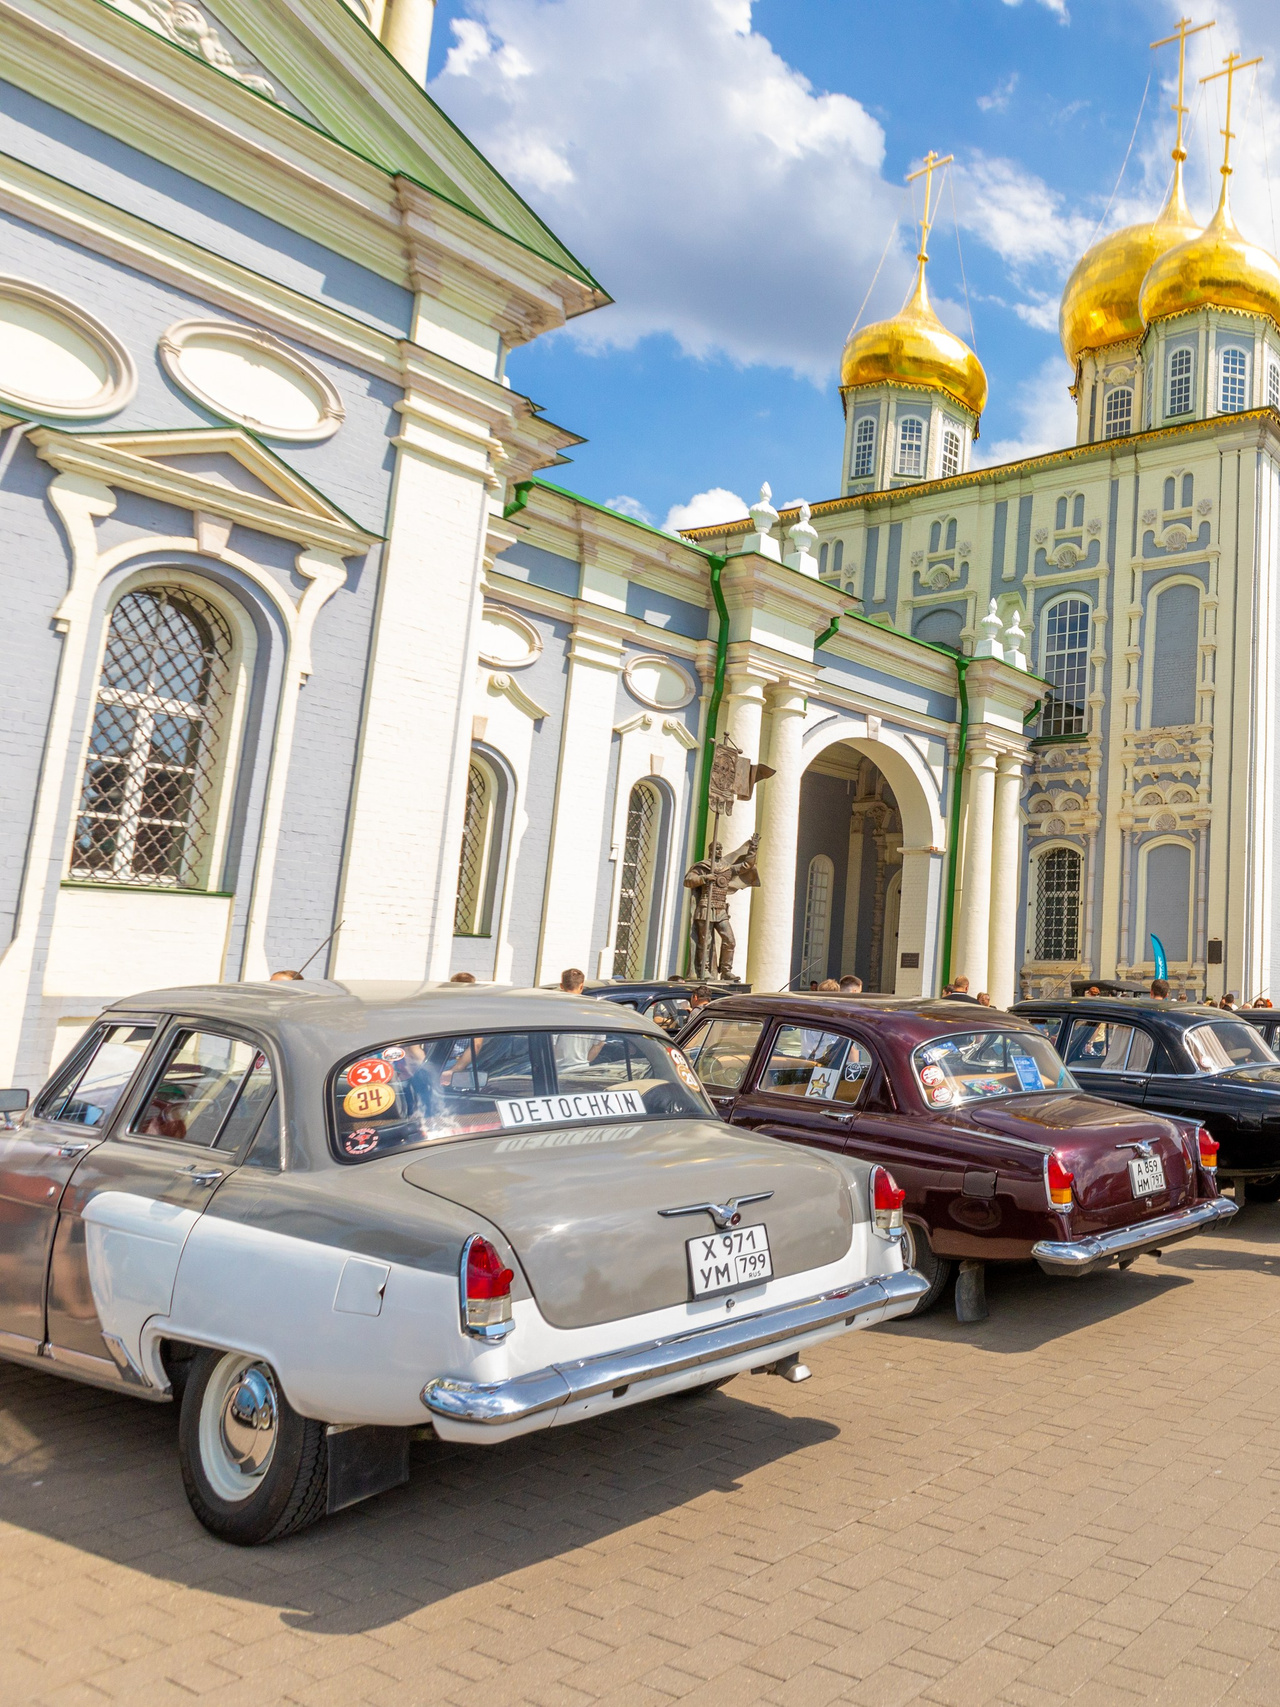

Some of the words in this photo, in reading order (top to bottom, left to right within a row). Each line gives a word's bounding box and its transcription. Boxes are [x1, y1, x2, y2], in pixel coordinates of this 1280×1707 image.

[356, 1064, 386, 1083] 31
[357, 1089, 382, 1111] 34
[508, 1092, 638, 1124] DETOCHKIN
[1145, 1160, 1158, 1174] 859
[702, 1239, 717, 1261] Х
[723, 1230, 756, 1256] 971
[700, 1263, 731, 1289] УМ
[739, 1253, 766, 1274] 799
[748, 1270, 762, 1278] RUS
